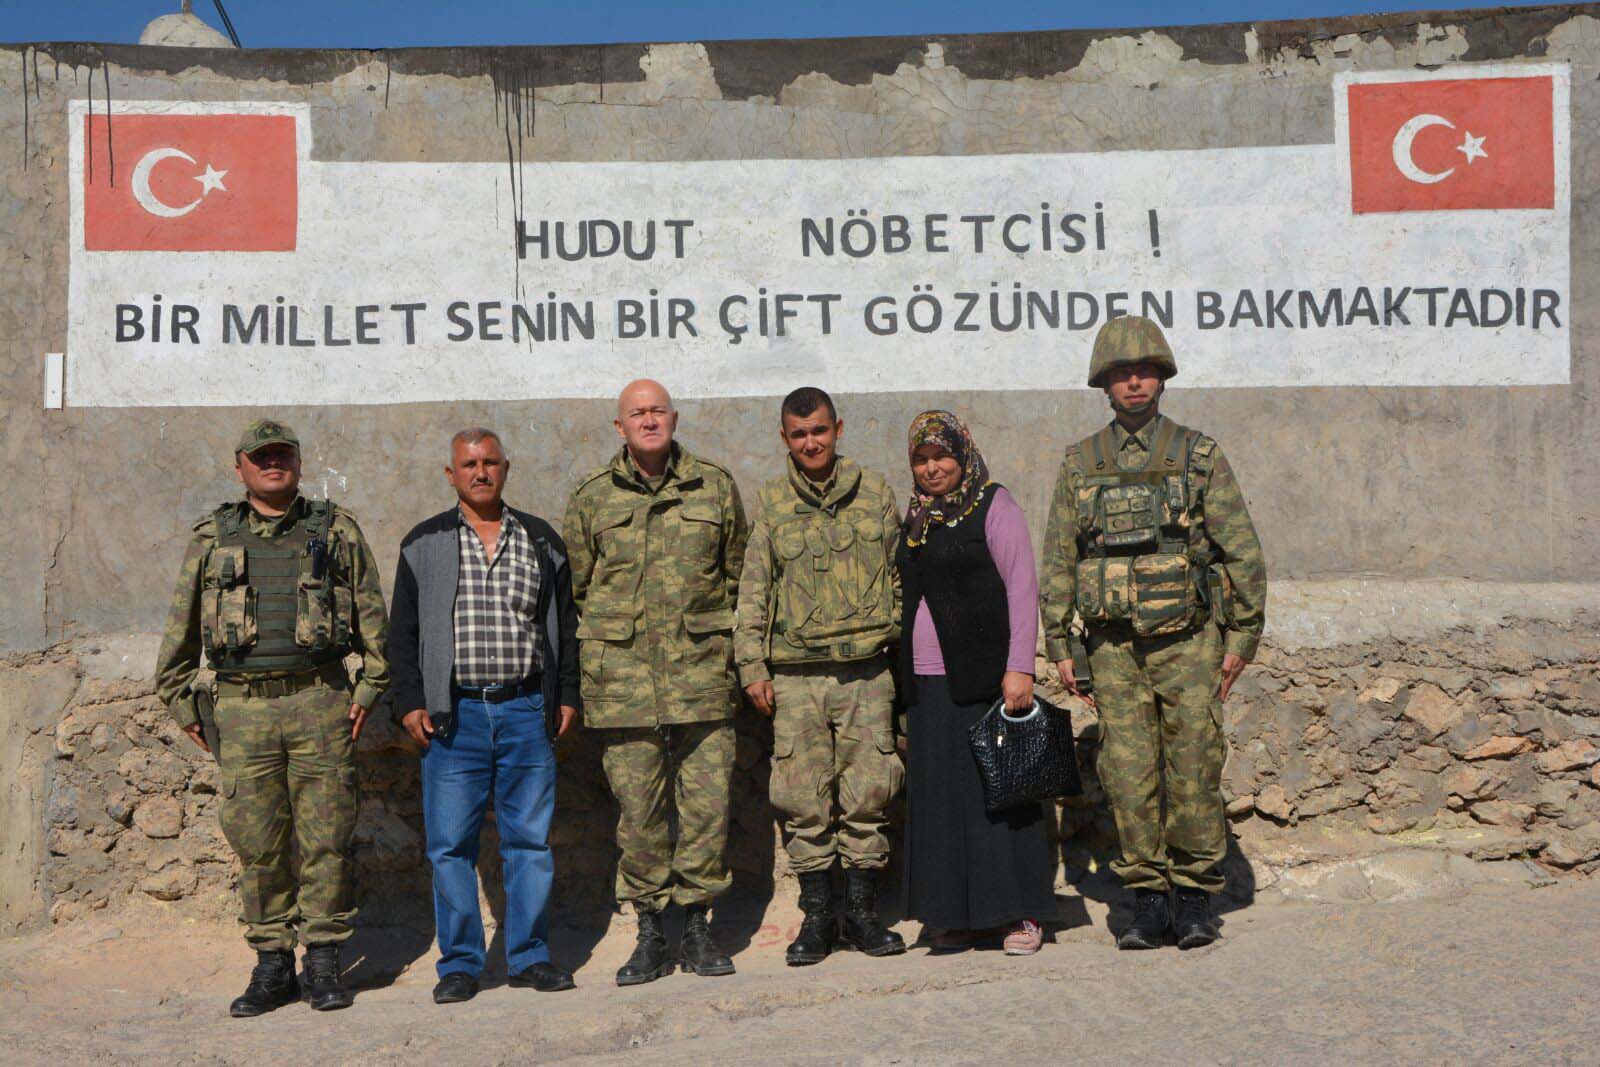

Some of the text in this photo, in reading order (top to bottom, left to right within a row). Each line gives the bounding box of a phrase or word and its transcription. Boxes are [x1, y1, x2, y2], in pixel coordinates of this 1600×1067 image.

[517, 219, 695, 262] HUDUT
[1148, 208, 1161, 258] !
[115, 281, 1562, 347] BİR MİLLET SENİN BİR ÇİFT GÖZÜNDEN BAKMAKTADIR
